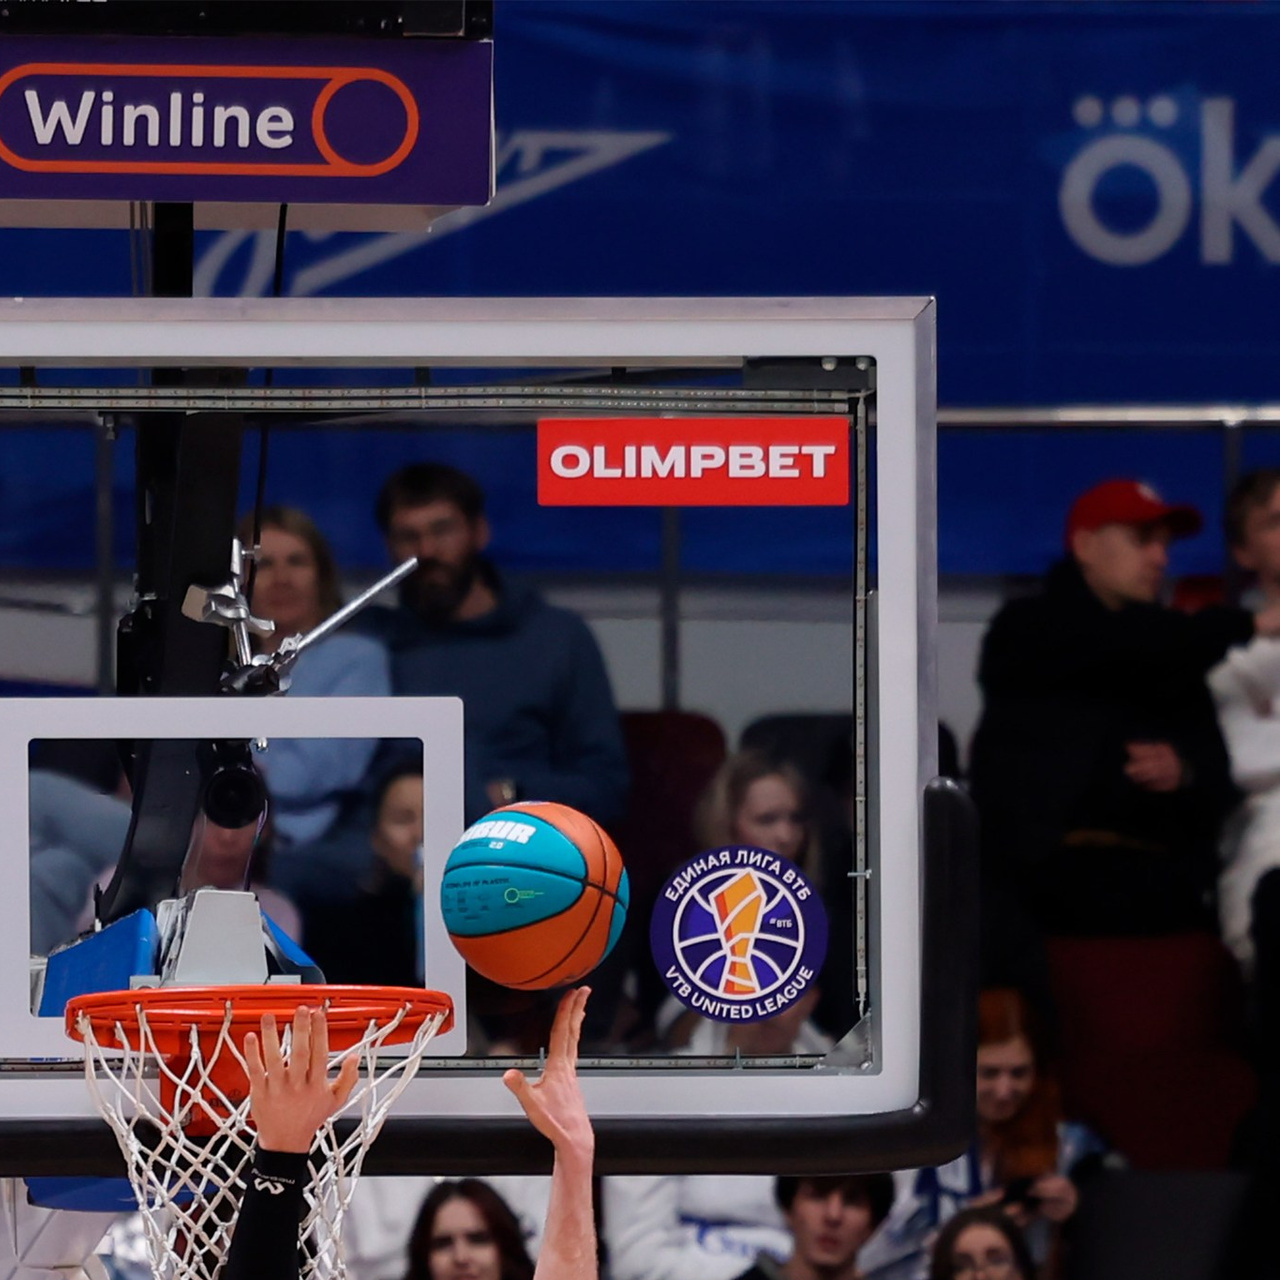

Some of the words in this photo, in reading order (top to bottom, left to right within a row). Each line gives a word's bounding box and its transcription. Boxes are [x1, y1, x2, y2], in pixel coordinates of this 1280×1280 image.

[24, 89, 295, 150] Winline
[549, 444, 837, 480] OLIMPBET
[665, 851, 730, 901] ЕДИНАЯ
[735, 850, 781, 875] ЛИГА
[782, 869, 811, 901] ВТБ
[665, 965, 693, 998] VTB
[691, 992, 753, 1018] UNITED
[755, 965, 814, 1016] LEAGUE
